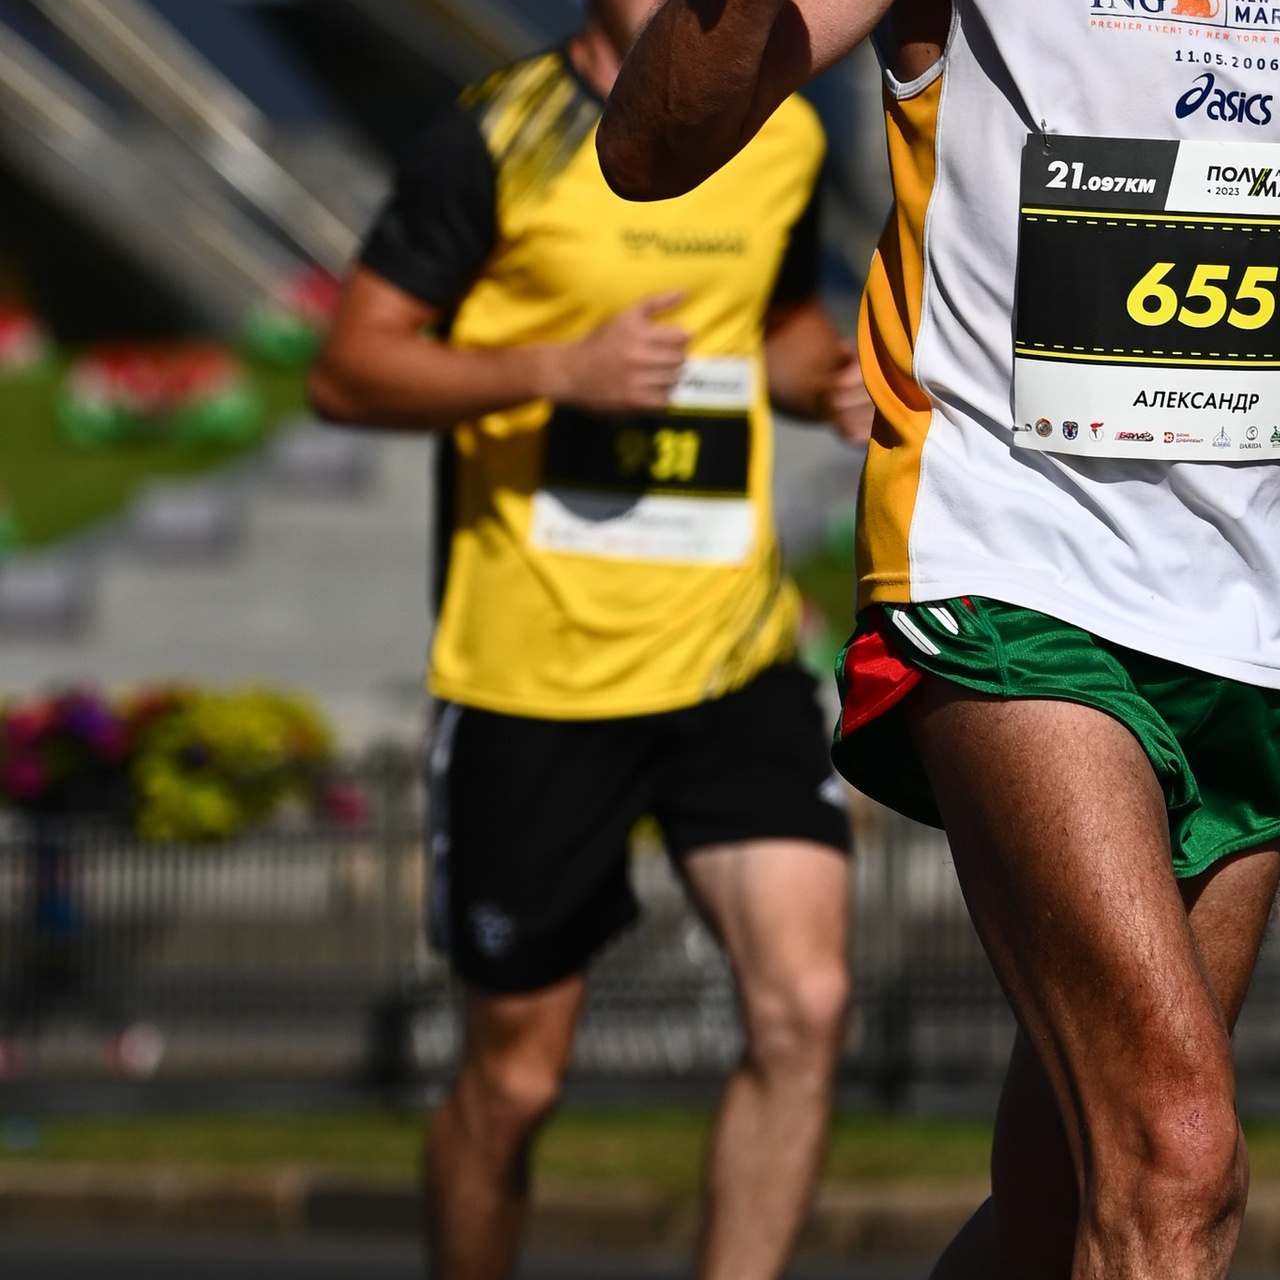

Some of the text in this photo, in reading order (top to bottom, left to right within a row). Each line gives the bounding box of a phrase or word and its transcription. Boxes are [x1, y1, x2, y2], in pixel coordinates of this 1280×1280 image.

[1090, 20, 1142, 31] PREMIER
[1148, 25, 1183, 35] EVENT
[1188, 29, 1200, 38] OF
[1207, 31, 1230, 41] NEW
[1237, 33, 1267, 44] YORK
[1174, 49, 1280, 71] 11.05.2006
[1215, 186, 1240, 196] 2023
[1126, 262, 1279, 330] 655
[1133, 389, 1260, 413] АЛЕКСАНДР
